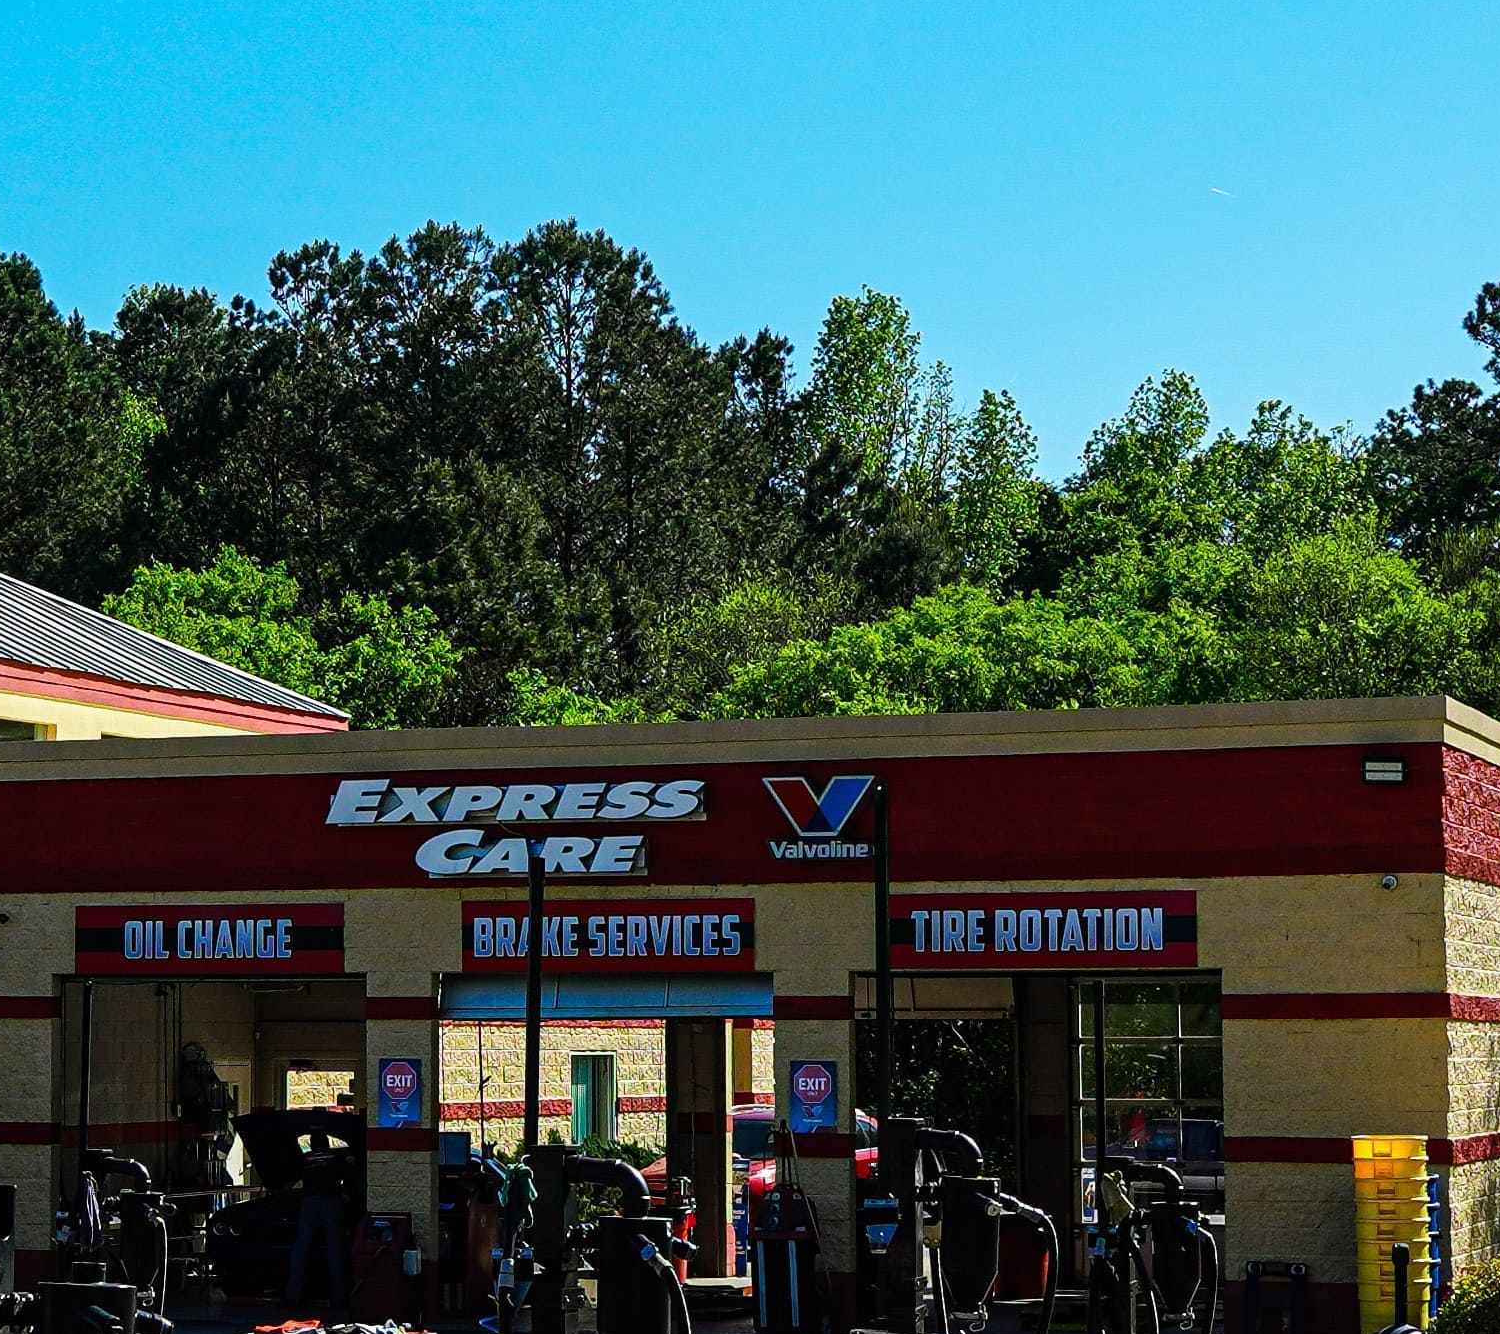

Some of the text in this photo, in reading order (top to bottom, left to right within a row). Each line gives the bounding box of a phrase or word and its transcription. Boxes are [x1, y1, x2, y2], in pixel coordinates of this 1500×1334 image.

[325, 778, 705, 824] EXPRESS
[414, 829, 645, 874] CARE
[768, 840, 869, 859] Valvoline
[123, 918, 294, 960] OIL CHANGE
[586, 913, 742, 957] SERVICES
[910, 907, 1165, 953] TIRE ROTATION
[386, 1074, 413, 1088] EXIT
[798, 1077, 827, 1090] EXIT
